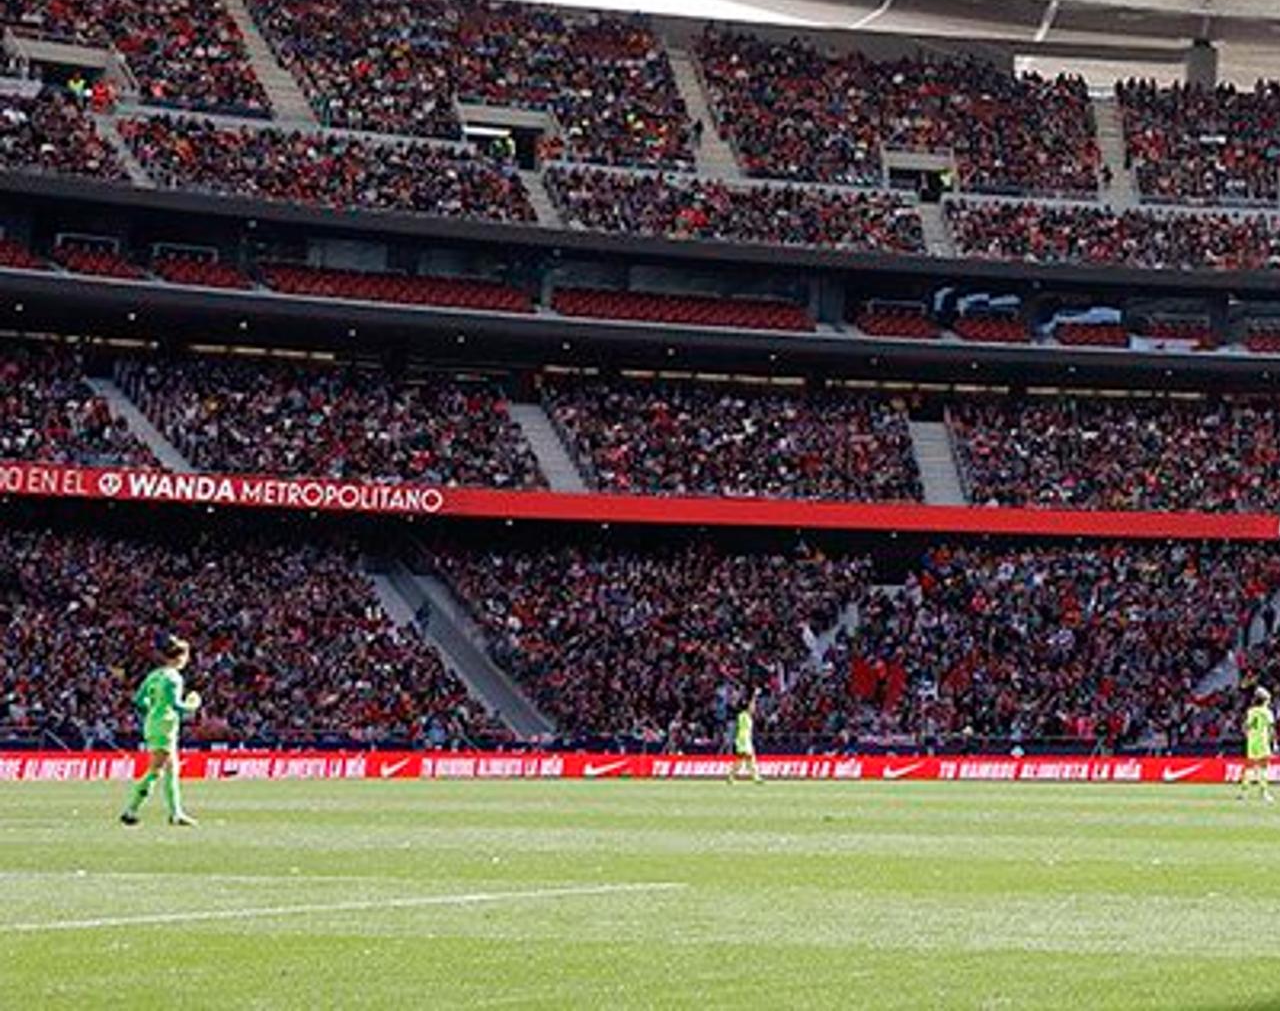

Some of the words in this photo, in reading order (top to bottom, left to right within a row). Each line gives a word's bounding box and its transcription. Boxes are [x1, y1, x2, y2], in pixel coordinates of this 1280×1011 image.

[28, 468, 60, 495] EN
[63, 469, 90, 495] EL
[129, 473, 237, 504] WANDA
[240, 479, 444, 513] METROPOLITANO
[959, 762, 1020, 779] HAMBRE
[1020, 762, 1090, 780] ALIMENTA
[1090, 762, 1111, 780] LA
